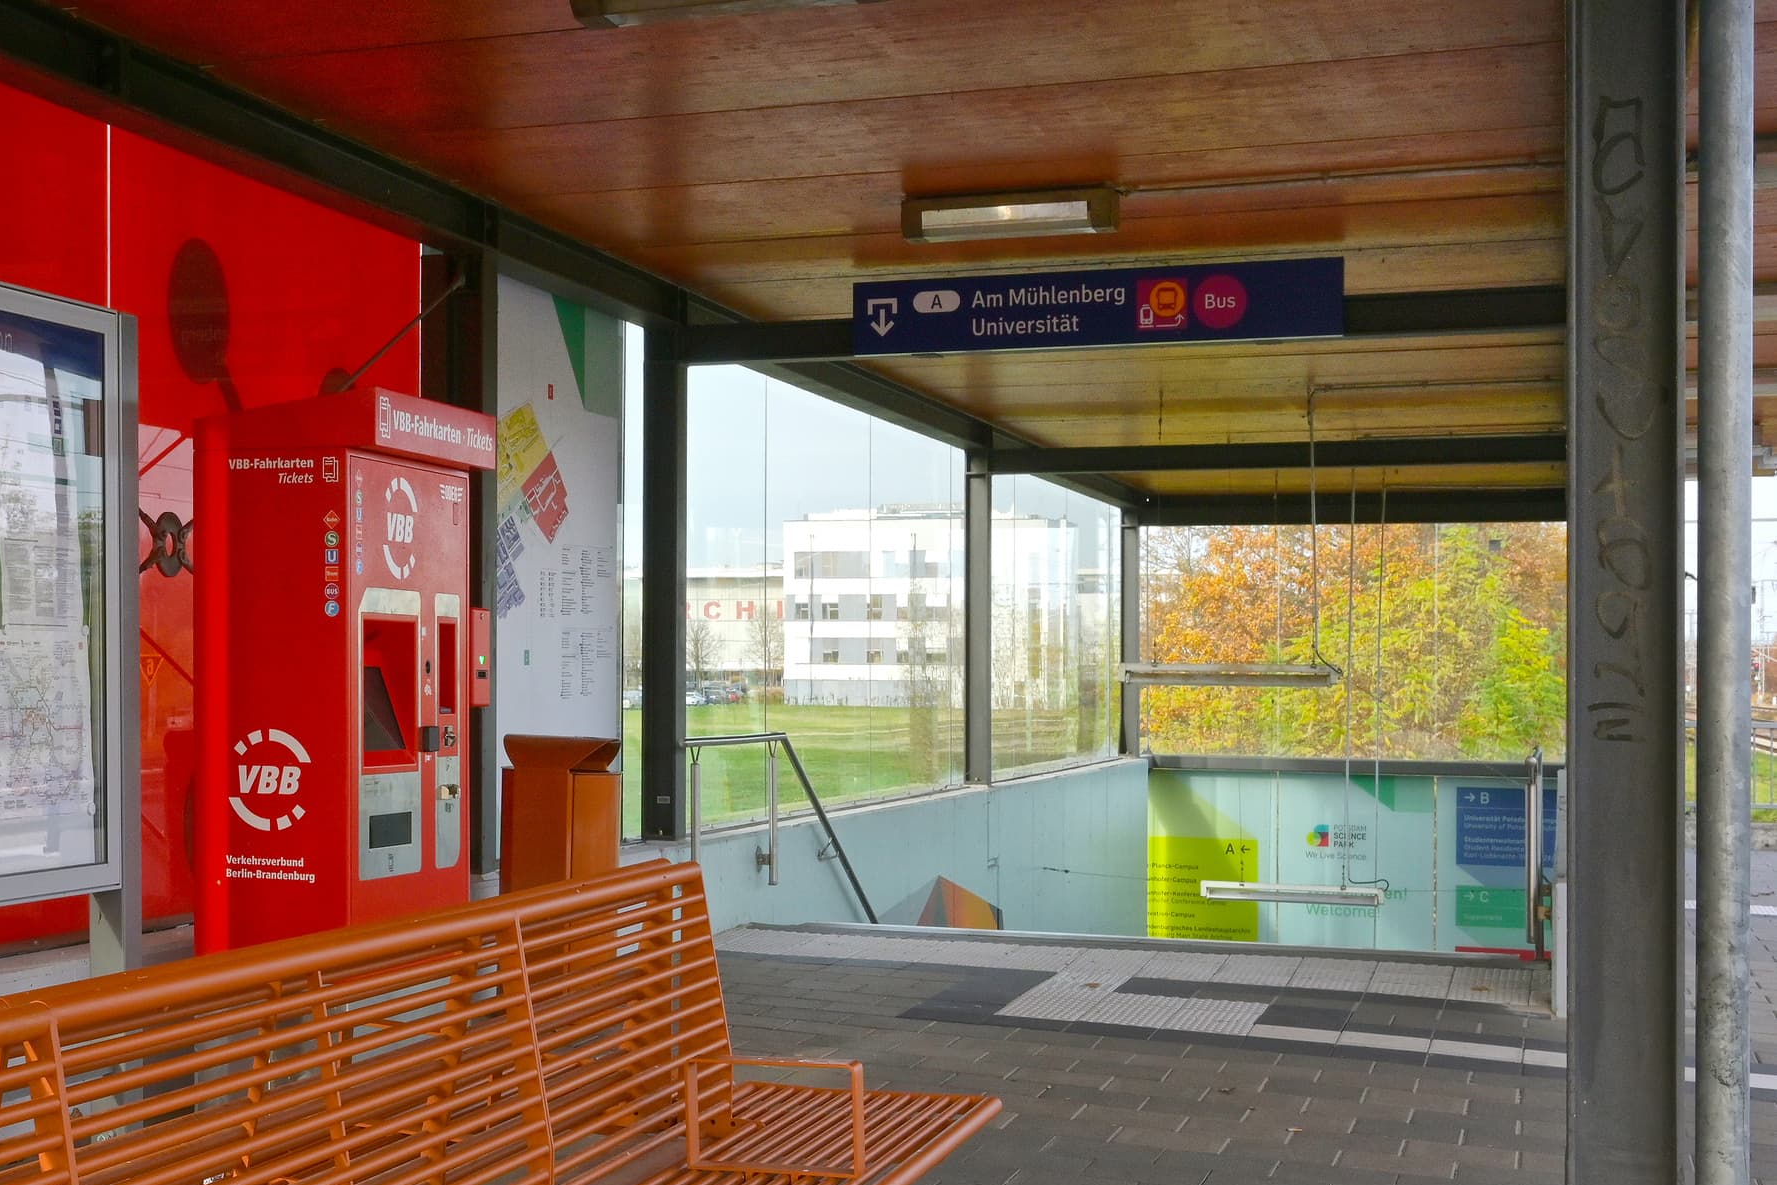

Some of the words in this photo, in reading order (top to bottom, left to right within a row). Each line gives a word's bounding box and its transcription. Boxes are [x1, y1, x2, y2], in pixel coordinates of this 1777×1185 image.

[930, 294, 943, 309] A
[972, 290, 1003, 308] Am
[1009, 283, 1126, 307] Mühlenberg
[1205, 294, 1236, 309] Bus
[972, 314, 1079, 337] Universität
[393, 409, 461, 444] VBB-Fahrkarten
[466, 427, 493, 452] Tickets
[229, 457, 314, 470] VBB-Fahrkarten
[278, 472, 314, 484] Tickets
[386, 511, 414, 544] VBB
[327, 534, 337, 545] S
[327, 550, 336, 562] U
[326, 587, 338, 595] BUS
[237, 764, 301, 795] VBB
[1480, 791, 1490, 804] B
[1225, 843, 1235, 854] A
[226, 854, 304, 868] Verkehrsverbund
[226, 868, 316, 884] Berlin-Brandenburg
[1480, 892, 1489, 902] C
